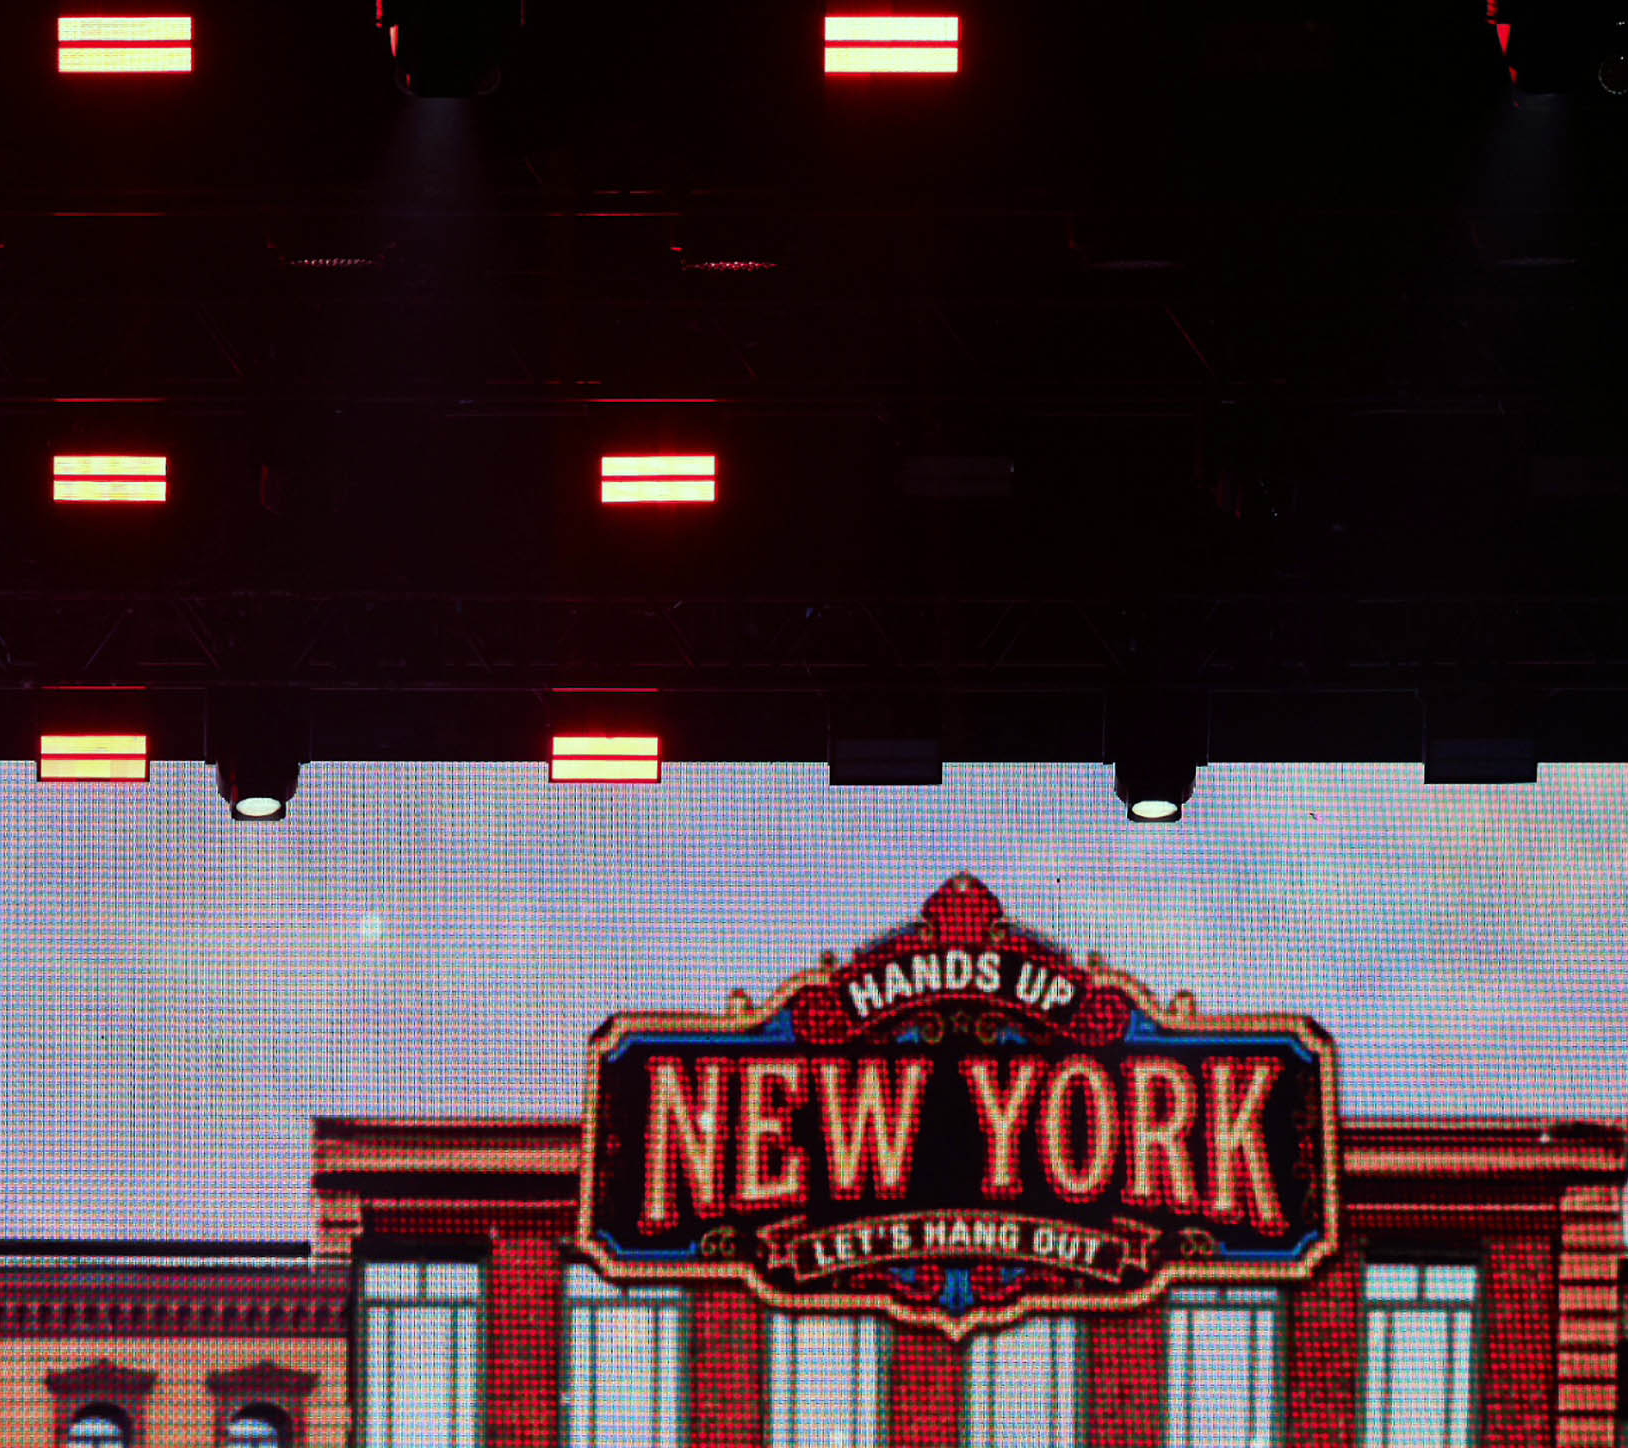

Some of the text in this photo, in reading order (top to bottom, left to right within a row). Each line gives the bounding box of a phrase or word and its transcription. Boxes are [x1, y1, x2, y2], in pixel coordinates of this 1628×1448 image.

[847, 949, 1078, 1017] HANDS UP
[638, 1054, 1285, 1238] NEW YORK
[813, 1215, 1104, 1268] LET'S HANG OUT
